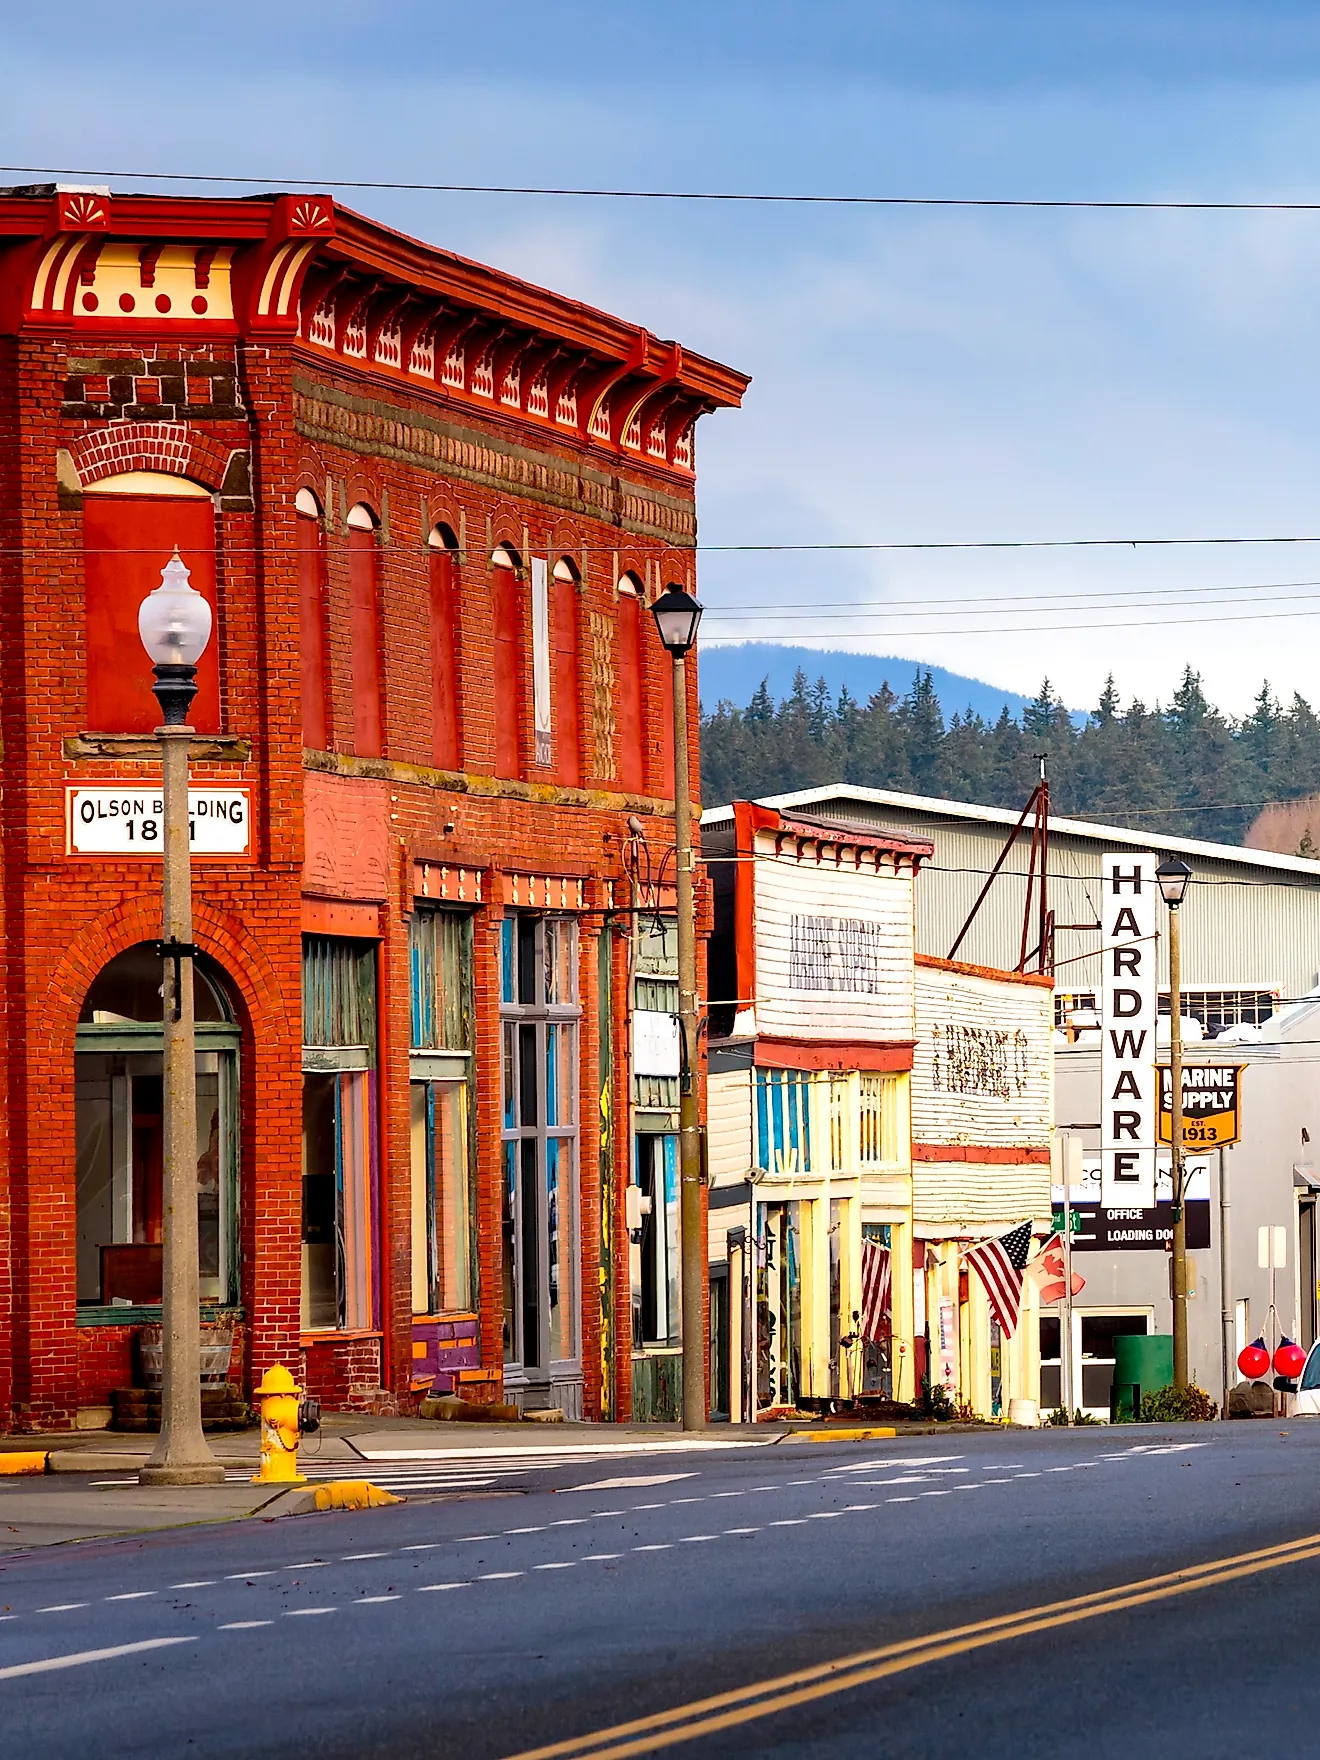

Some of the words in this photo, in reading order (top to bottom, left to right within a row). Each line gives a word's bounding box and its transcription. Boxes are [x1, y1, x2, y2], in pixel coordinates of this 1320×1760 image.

[80, 799, 145, 824] OLSON
[152, 799, 243, 824] BDING
[126, 819, 196, 841] 181
[1109, 865, 1147, 1182] HARDWARE
[1182, 1127, 1218, 1141] 1913
[1107, 1208, 1144, 1220] OFFICE
[1107, 1230, 1153, 1242] LOADING
